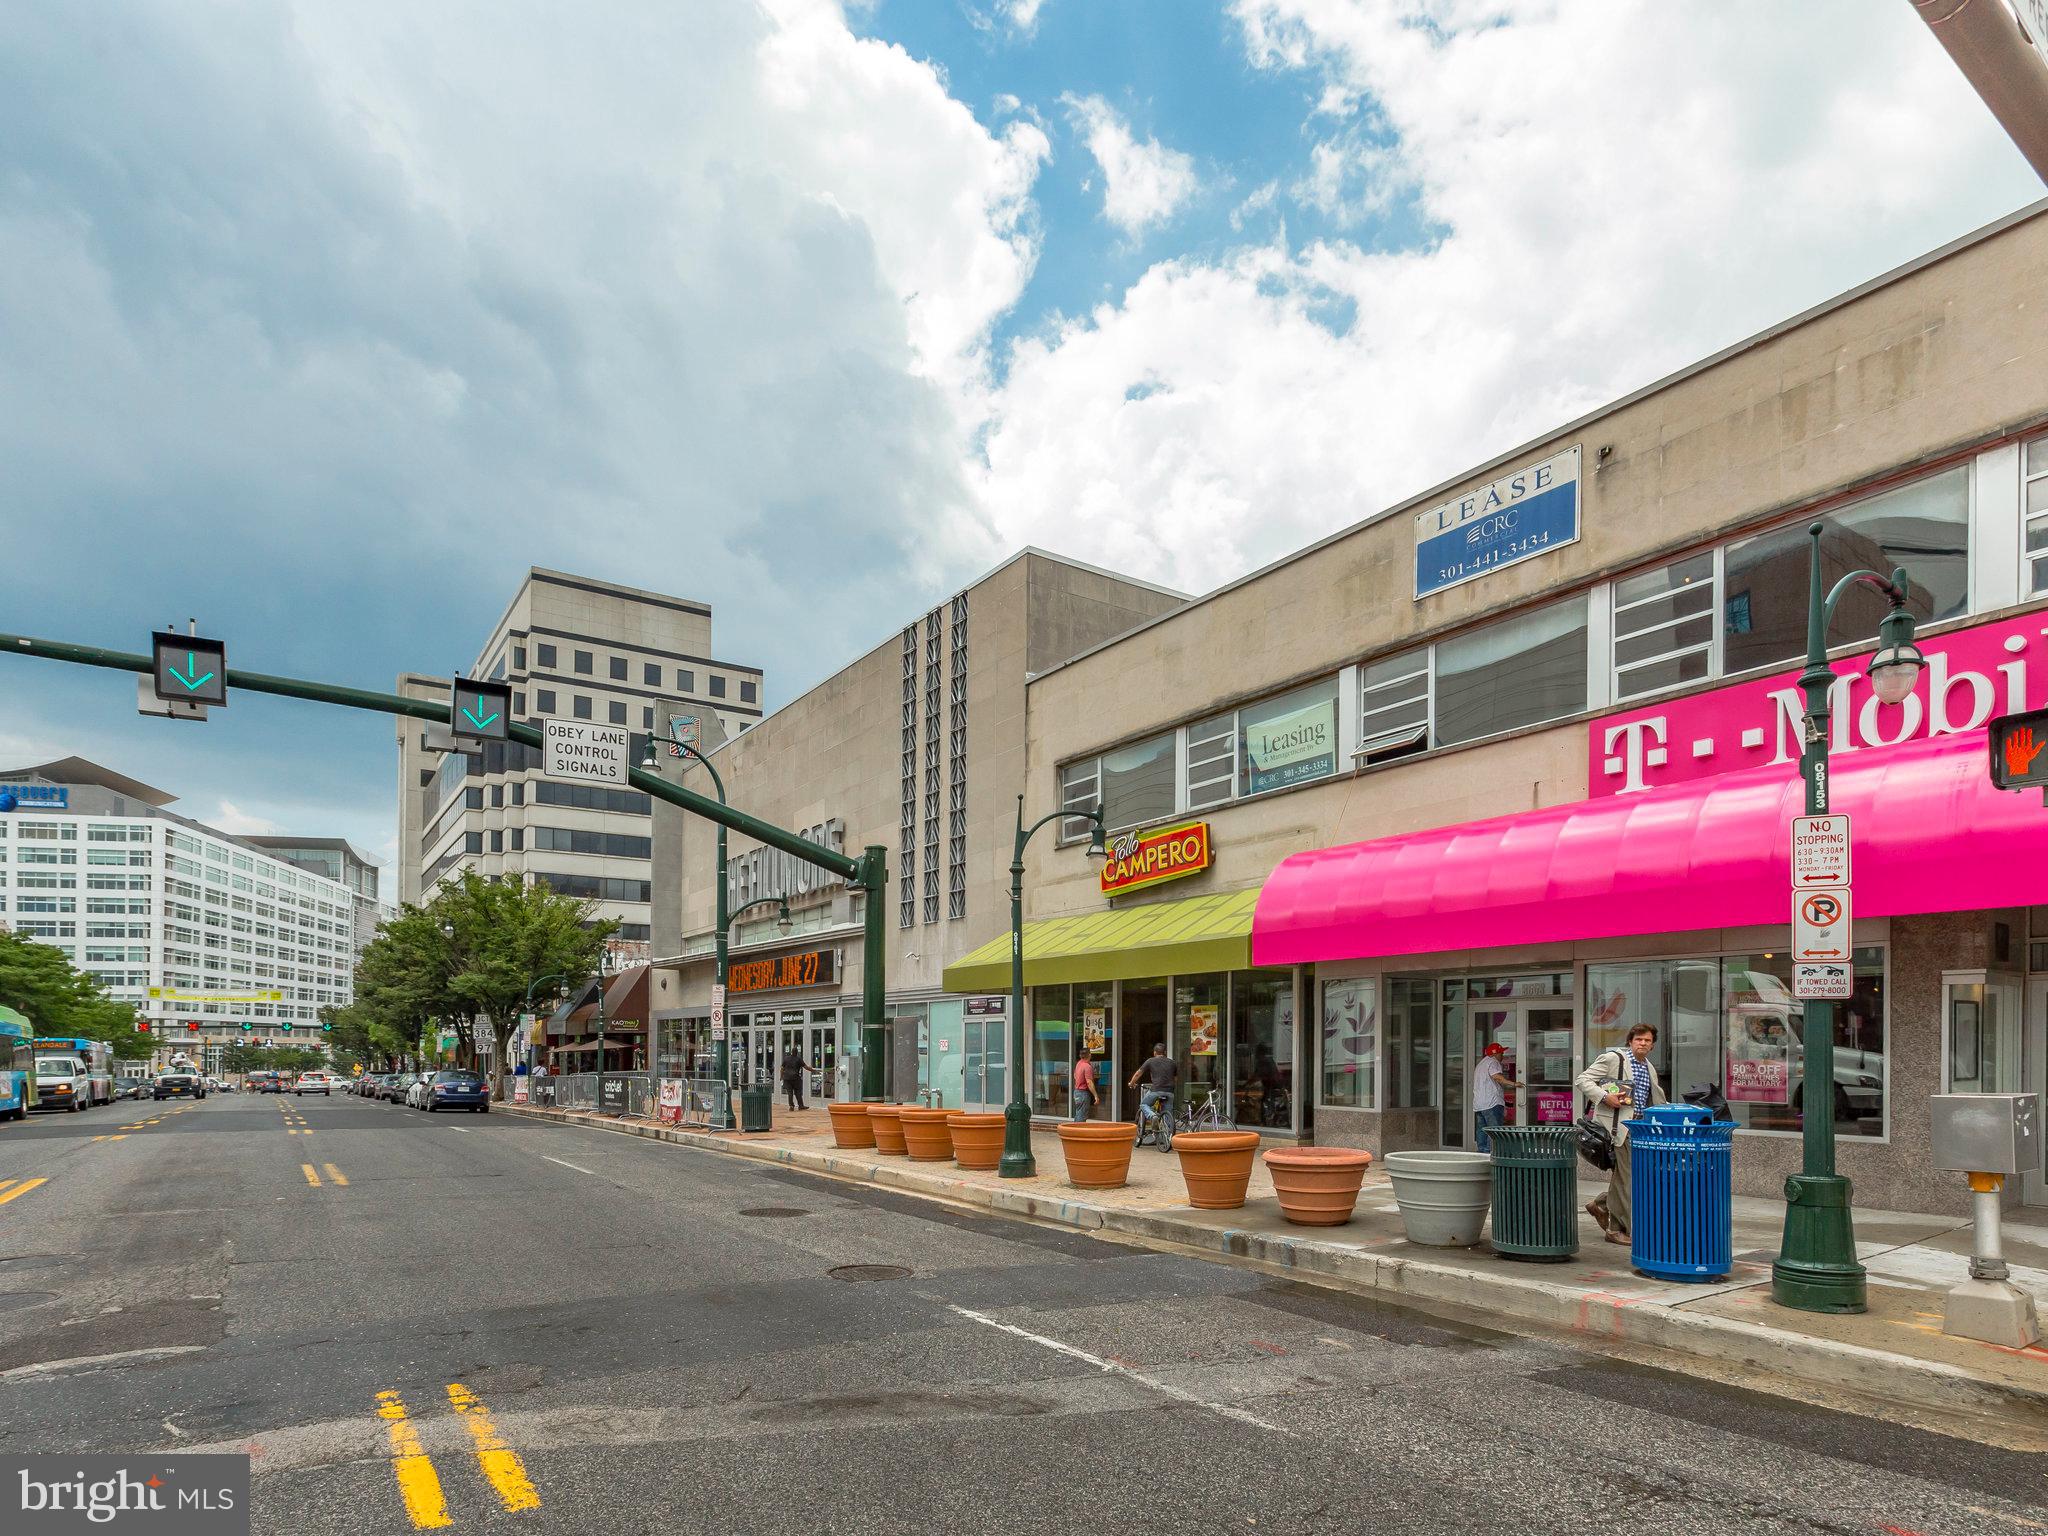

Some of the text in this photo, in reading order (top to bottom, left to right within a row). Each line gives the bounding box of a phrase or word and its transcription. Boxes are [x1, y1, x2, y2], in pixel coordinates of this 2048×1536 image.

[1437, 464, 1553, 532] LEASE
[1481, 509, 1519, 538] CRC
[1438, 530, 1549, 582] 301-441-3434
[548, 725, 625, 745] OBEY LANE
[1262, 722, 1326, 756] Leasing
[555, 742, 618, 761] CONTROL
[556, 759, 617, 777] SIGNALS
[1814, 762, 1826, 809] 08153
[1810, 820, 1831, 833] NO
[1111, 830, 1140, 862] Pollo
[1796, 833, 1844, 846] STOPPING
[1103, 835, 1201, 882] CAMPERO
[779, 955, 802, 987] JUNE
[803, 951, 819, 985] 27
[1798, 986, 1847, 995] 301-279-8000
[1805, 978, 1829, 986] TOWED
[1830, 977, 1848, 985] CALL
[476, 1015, 490, 1023] JCT
[474, 1029, 493, 1038] 384
[477, 1044, 491, 1053] 97
[1732, 1064, 1781, 1075] 50% OFF
